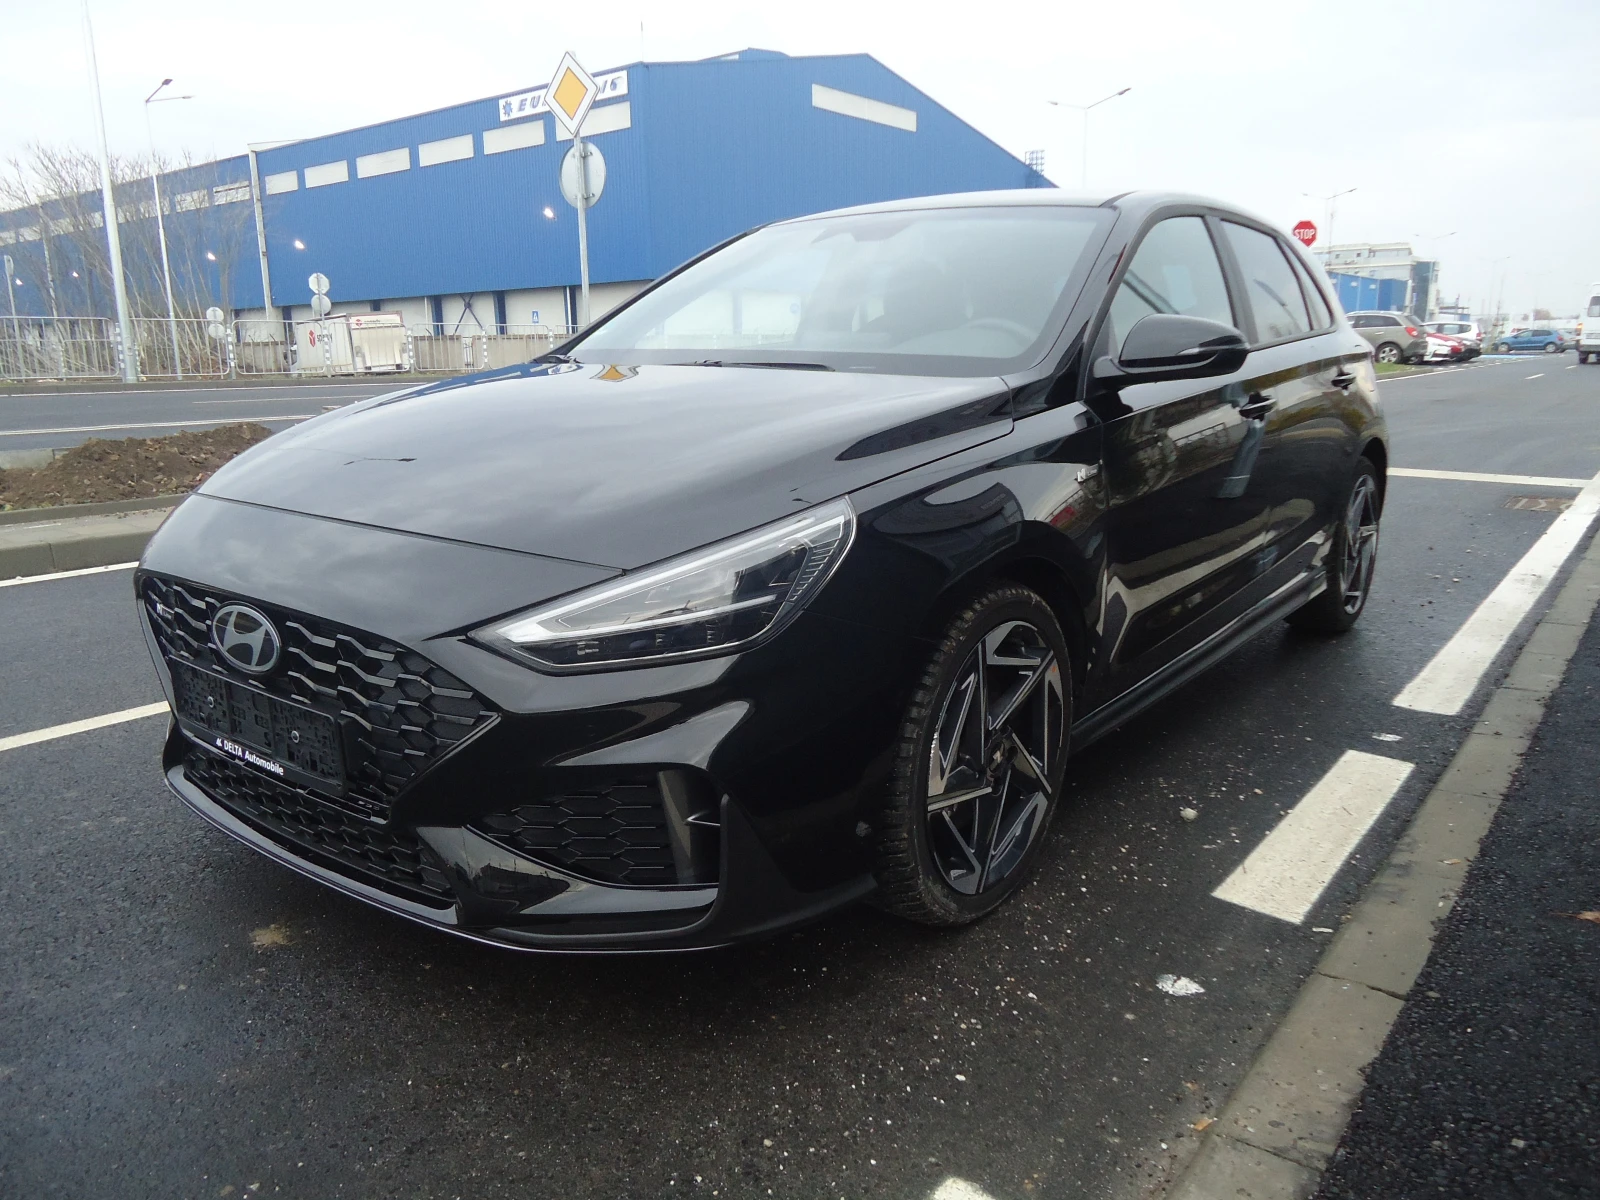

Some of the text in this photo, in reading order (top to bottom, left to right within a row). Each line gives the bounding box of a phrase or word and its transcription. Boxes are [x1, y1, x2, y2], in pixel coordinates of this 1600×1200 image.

[1294, 228, 1316, 240] STOP
[223, 740, 284, 775] DELTA Automobile
